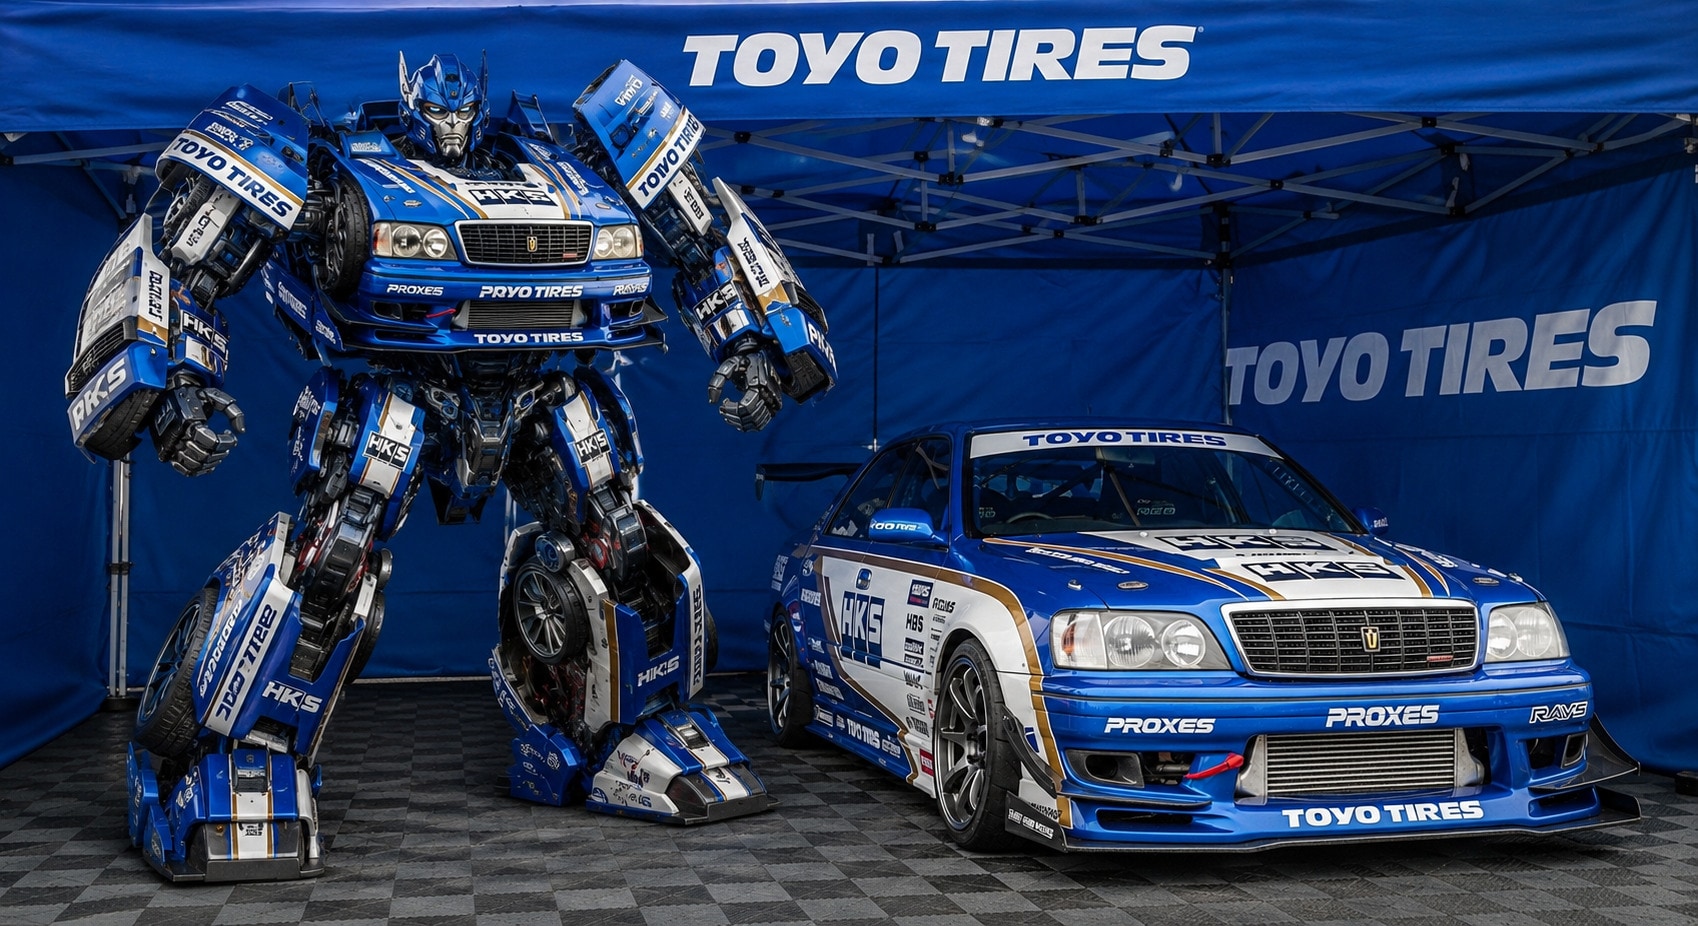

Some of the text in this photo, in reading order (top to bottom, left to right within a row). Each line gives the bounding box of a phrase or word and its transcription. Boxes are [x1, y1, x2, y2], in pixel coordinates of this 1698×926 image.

[683, 25, 1197, 87] TOYO TIRES
[172, 137, 293, 217] TOYO TIRES
[535, 285, 583, 298] TIRES
[183, 310, 227, 352] HKS
[474, 332, 583, 343] TOYO TIRES
[1225, 300, 1657, 405] TOYO TIRES
[366, 433, 411, 466] HKS
[575, 431, 609, 461] HKS
[1022, 431, 1227, 447] TOYO TIRES
[1245, 561, 1396, 577] HKS
[842, 596, 883, 645] HKS
[262, 681, 323, 713] HKS
[1103, 717, 1216, 734] PROXES
[1325, 705, 1440, 727] PROXES
[1281, 800, 1484, 829] TOYO TIRES
